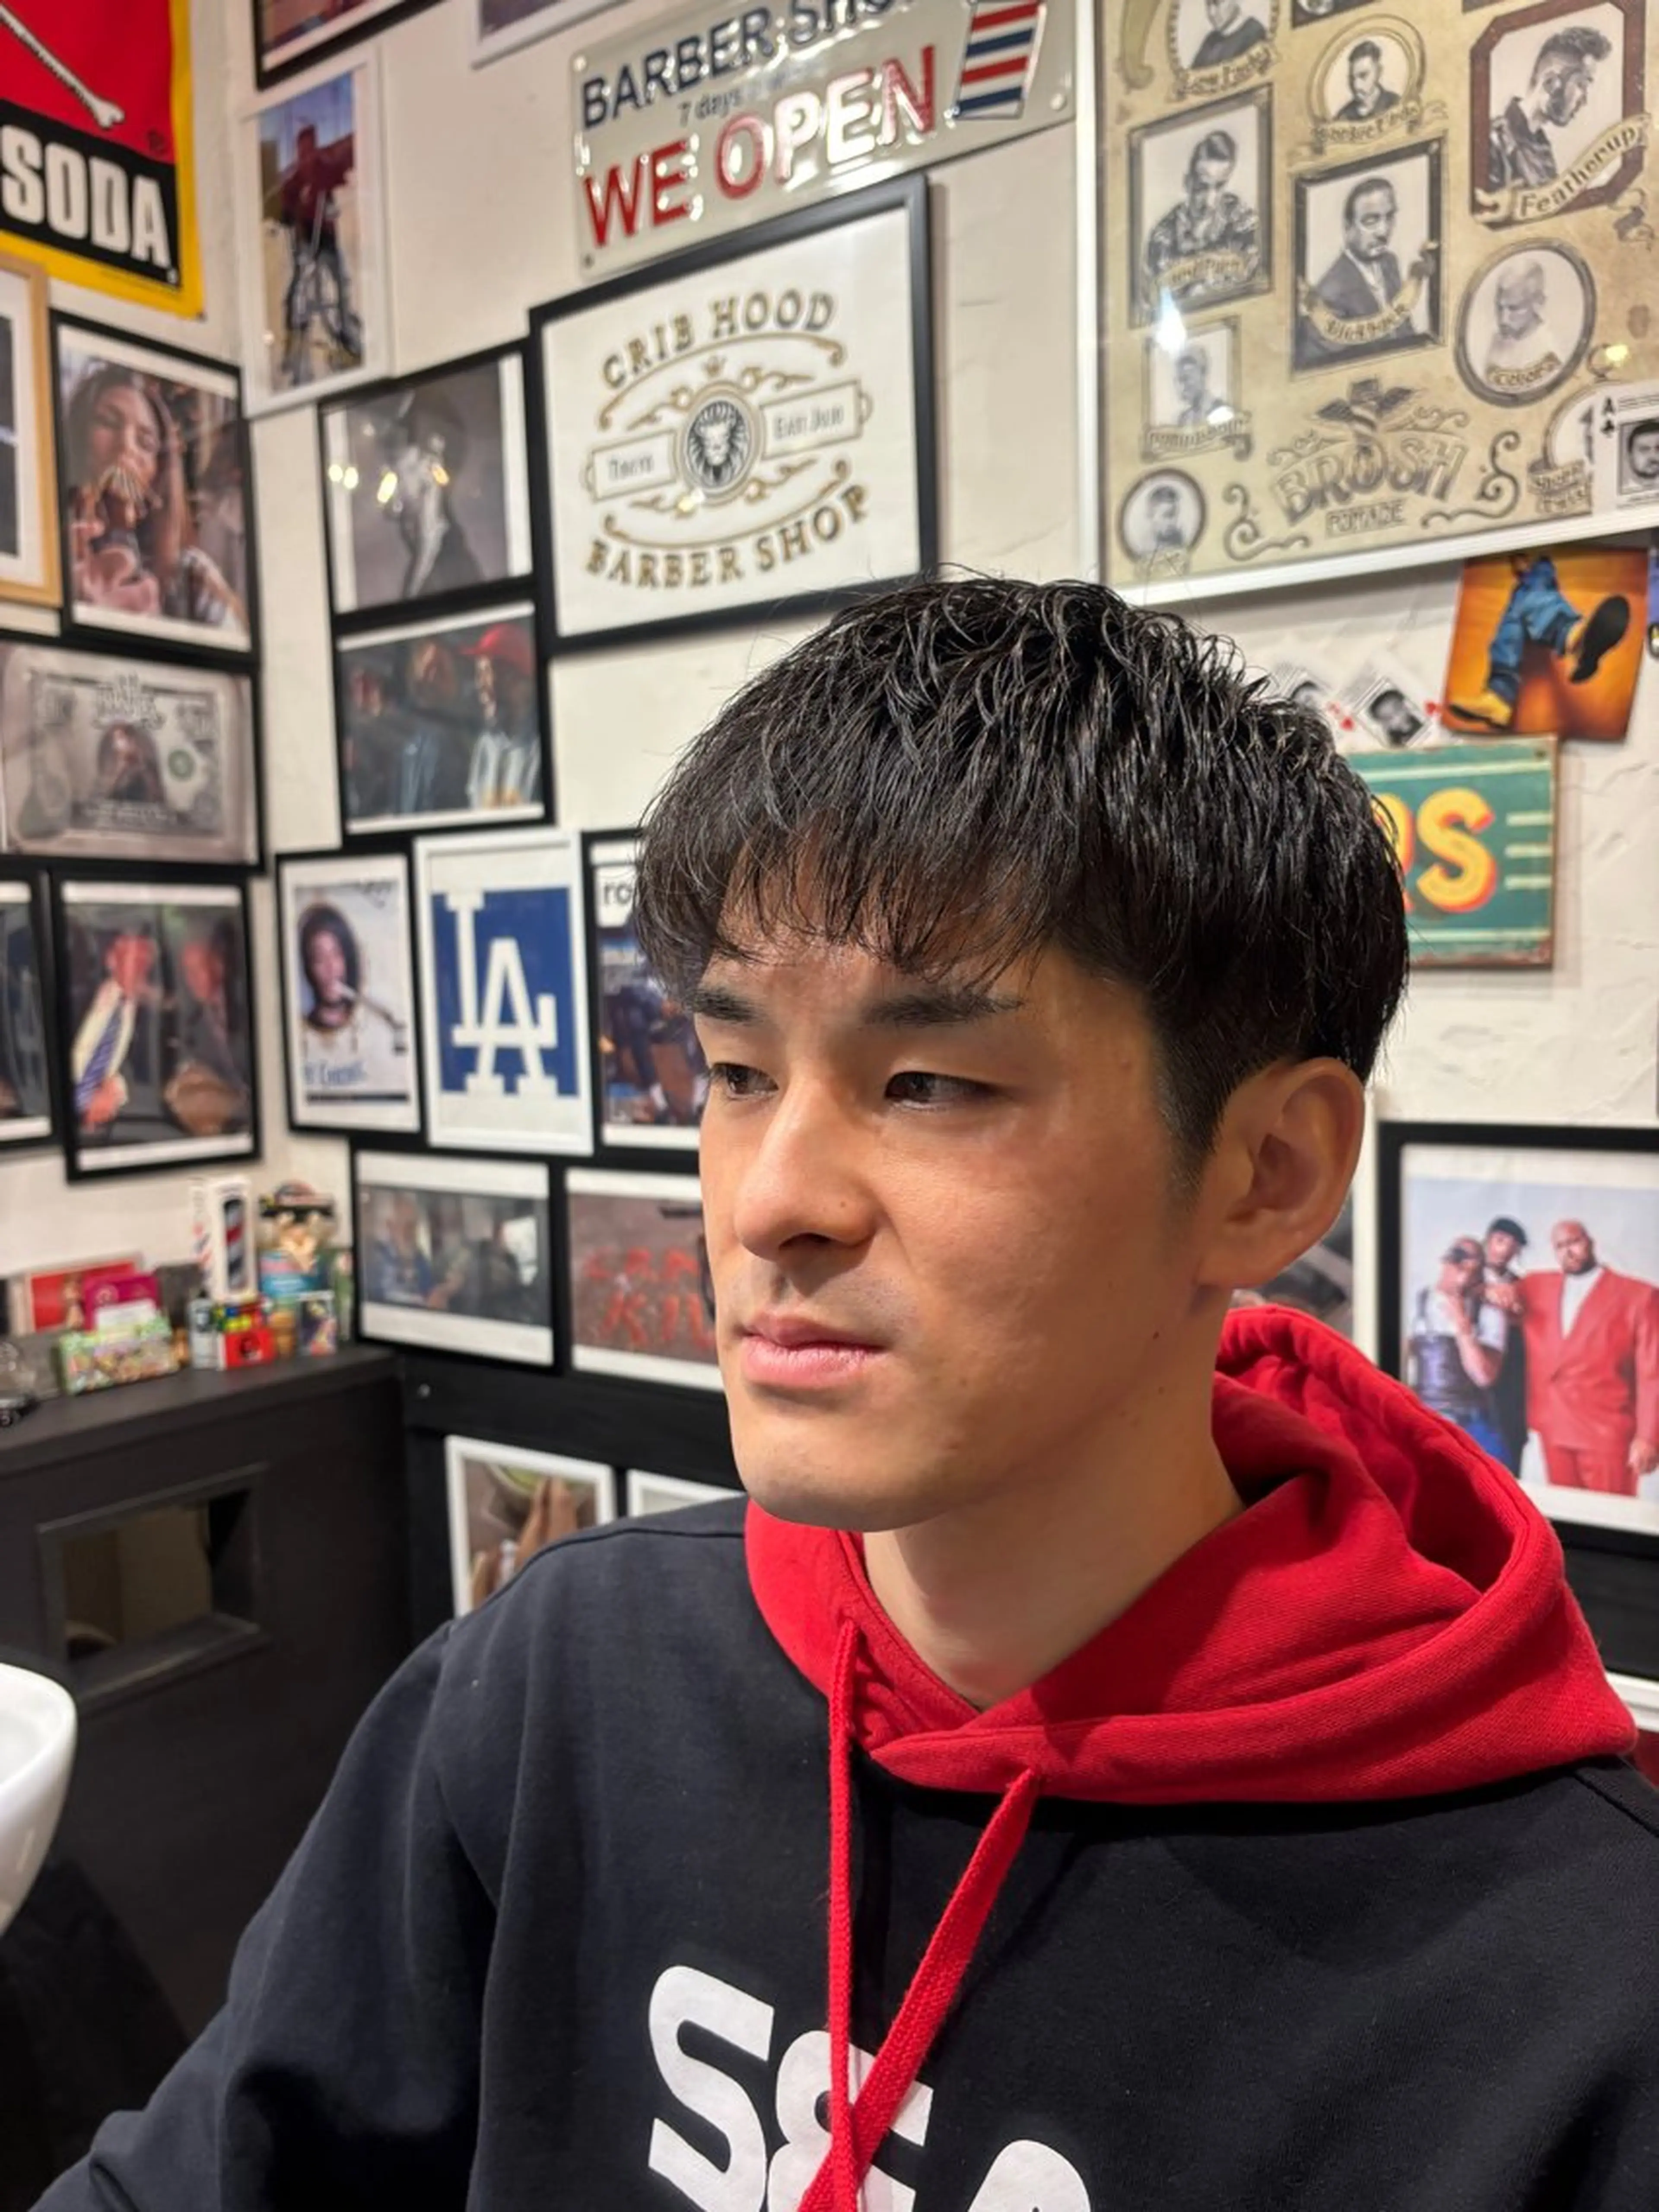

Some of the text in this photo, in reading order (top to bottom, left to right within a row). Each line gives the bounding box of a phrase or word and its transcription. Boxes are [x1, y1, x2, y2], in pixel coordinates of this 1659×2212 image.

[582, 6, 775, 130] BARBER
[1, 124, 171, 269] SODA
[583, 45, 935, 247] WE OPEN
[1519, 126, 1637, 218] Featherup
[602, 288, 836, 390] CRIB HOOD
[584, 483, 869, 589] BARBER SHOP
[447, 887, 558, 1097] LA
